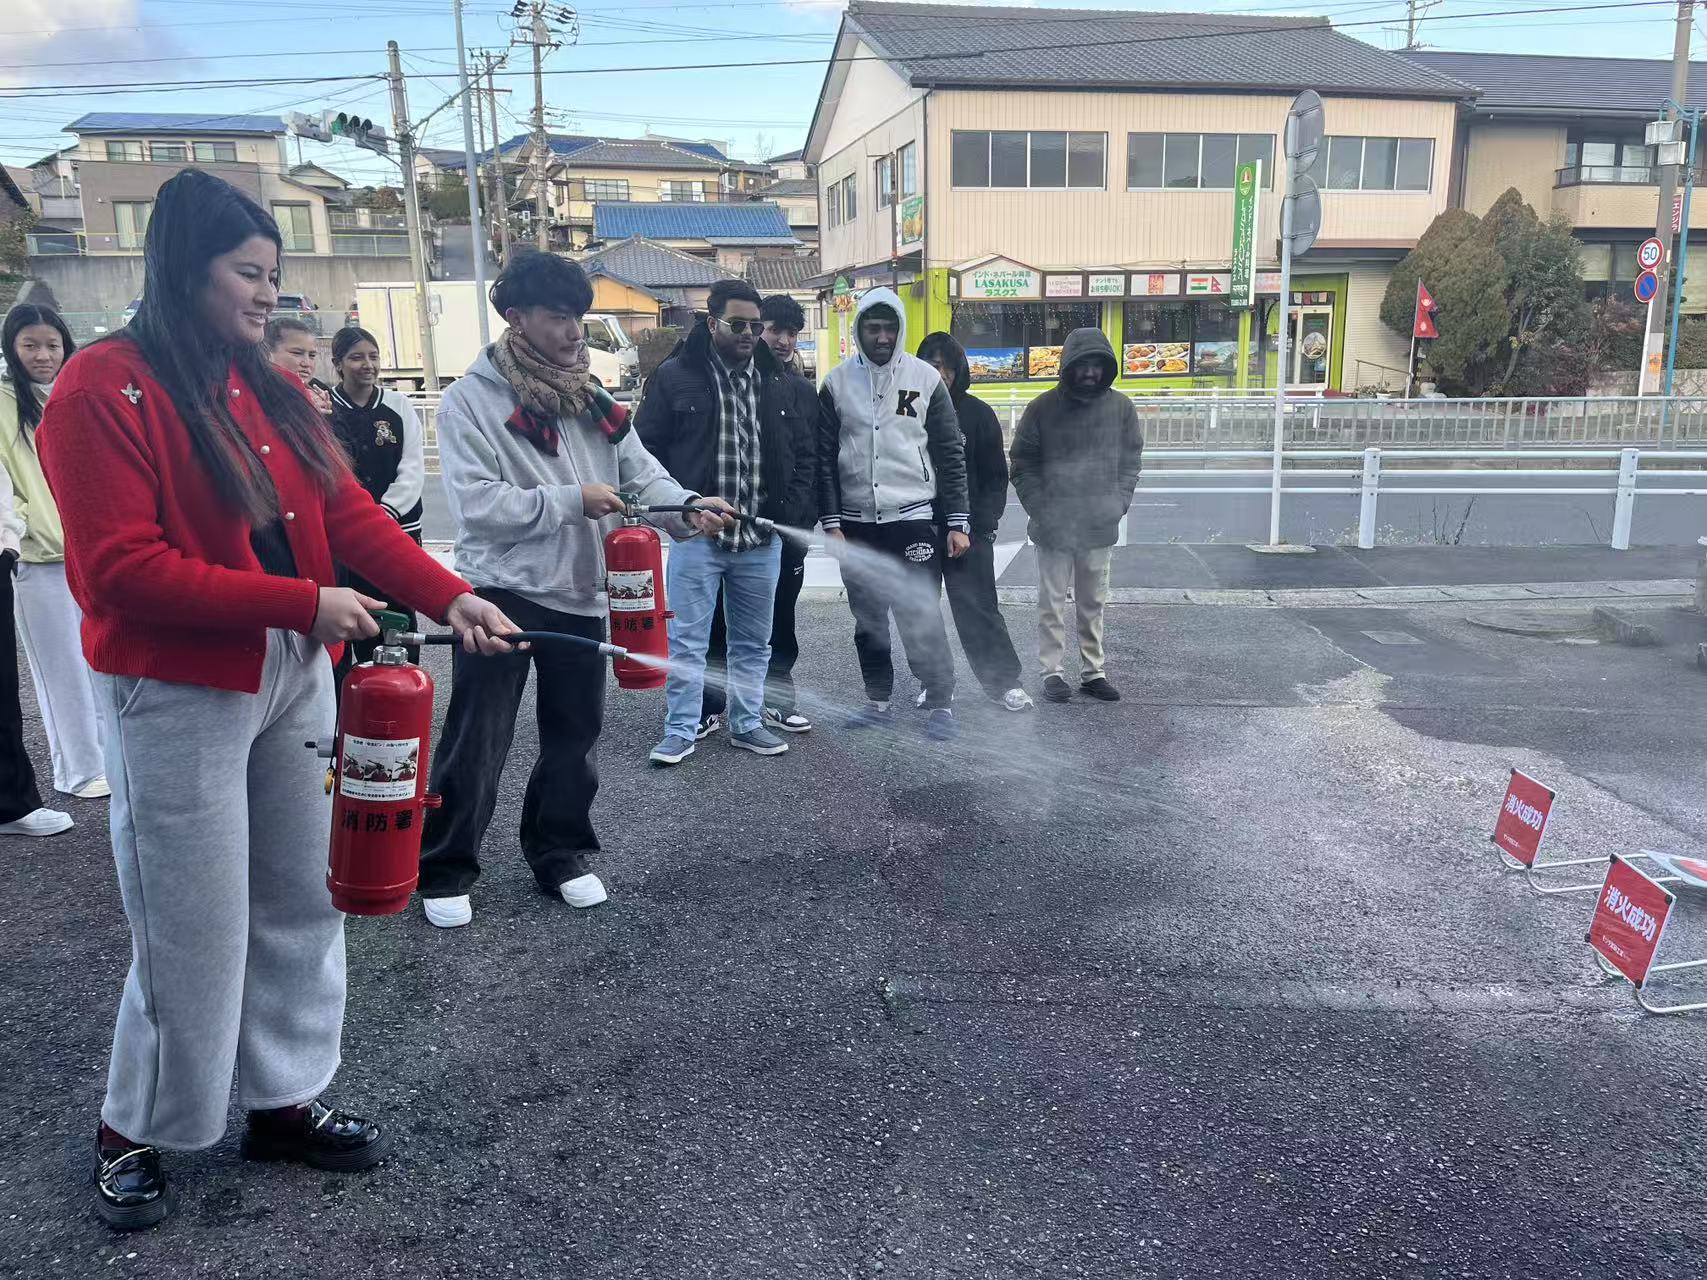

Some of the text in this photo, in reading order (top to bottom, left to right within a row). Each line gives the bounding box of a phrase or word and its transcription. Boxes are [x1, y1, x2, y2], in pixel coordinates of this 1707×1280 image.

[1644, 247, 1658, 261] 50
[975, 279, 1029, 288] LASAKUSA
[985, 288, 1019, 297] ラスクス
[896, 389, 920, 418] K
[341, 809, 413, 832] 消防署
[1505, 794, 1543, 831] 消火成功
[1603, 885, 1657, 942] 消火成功
